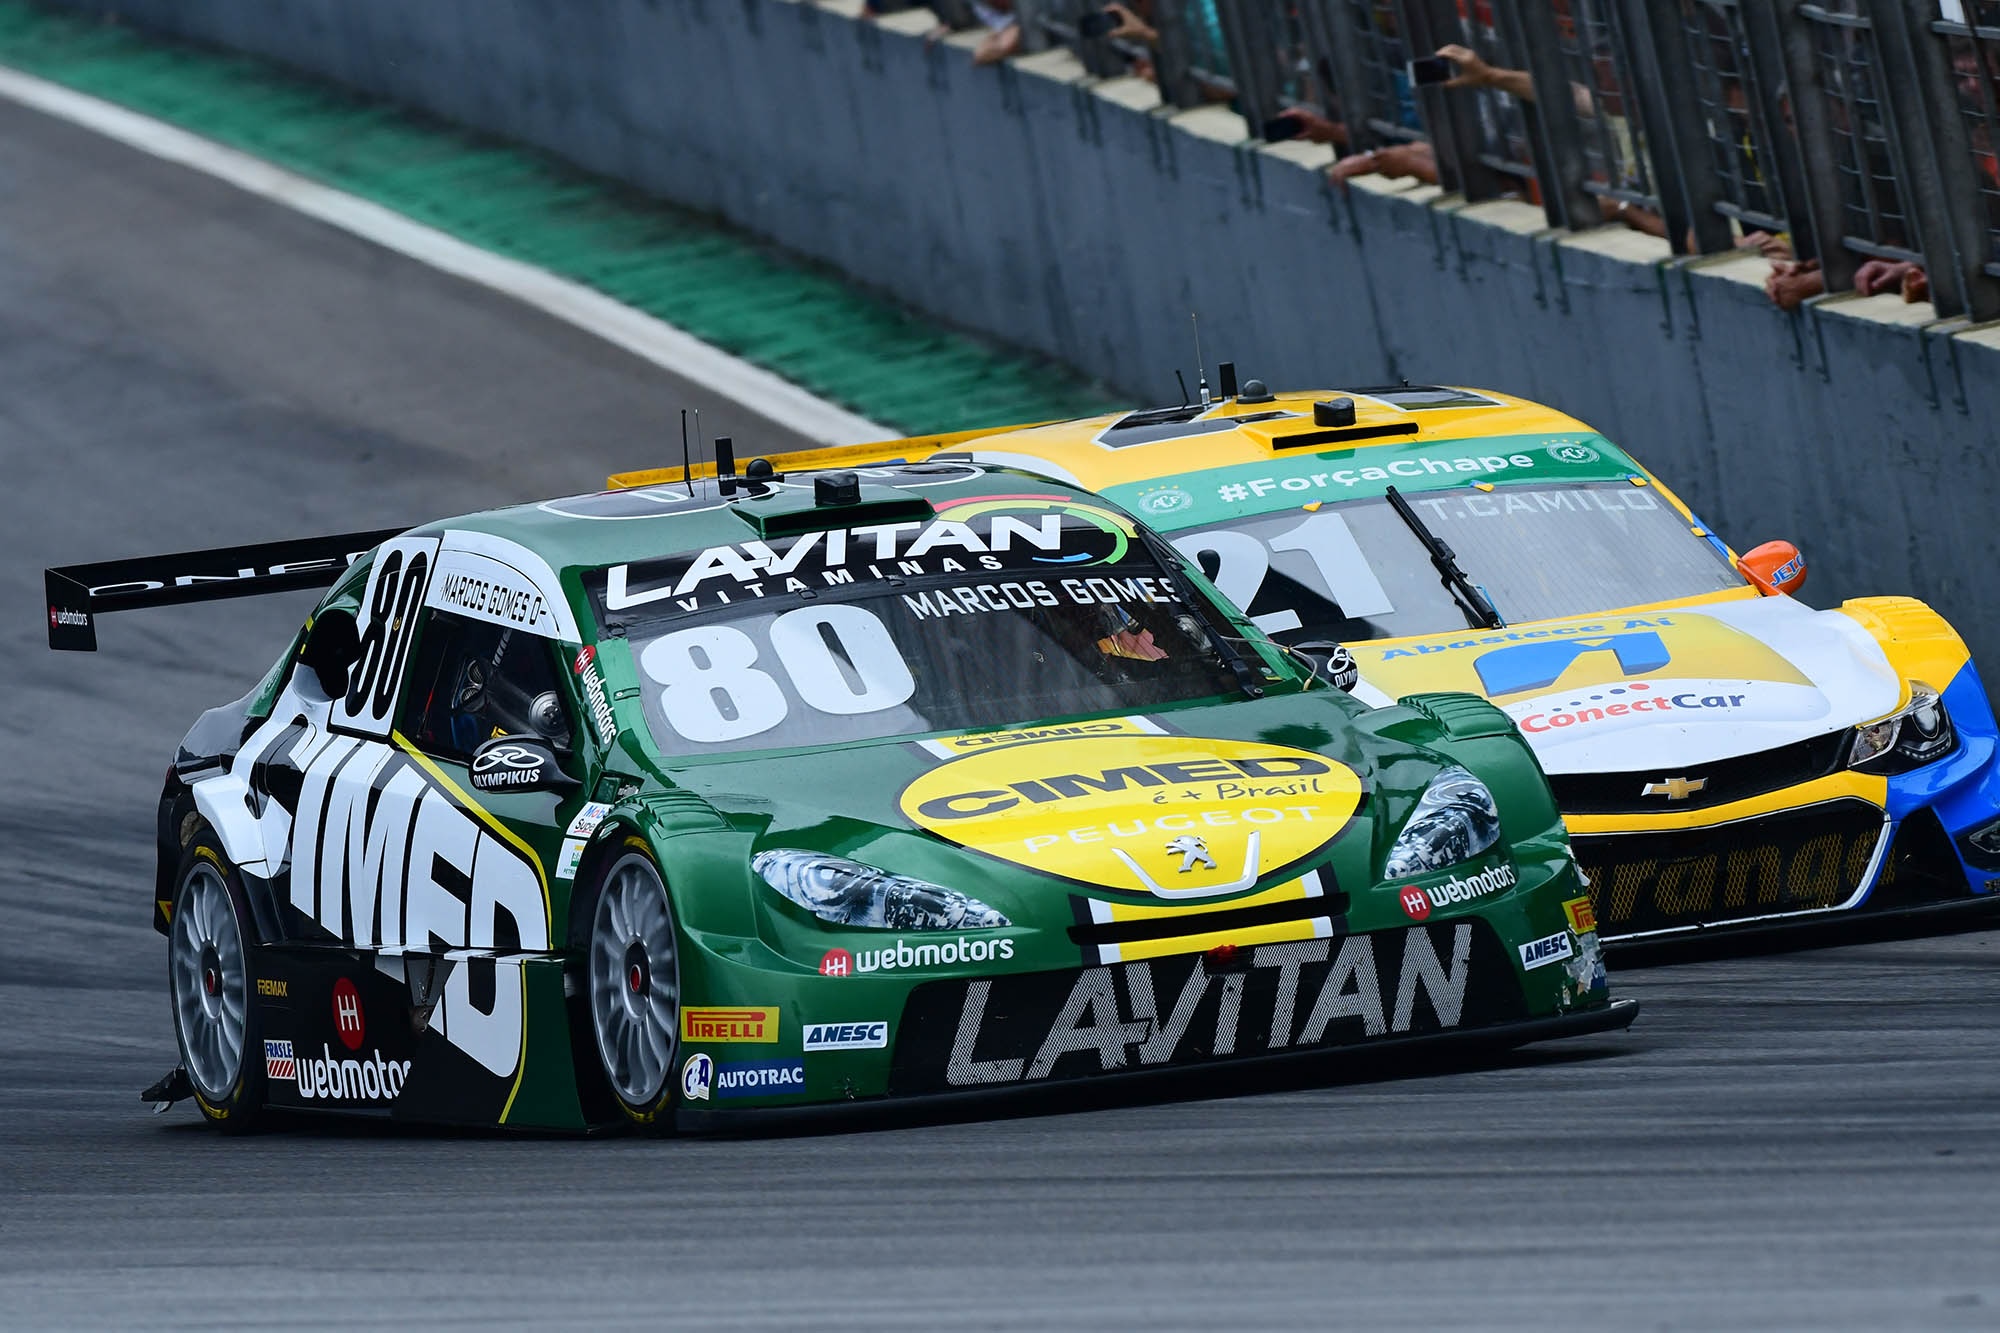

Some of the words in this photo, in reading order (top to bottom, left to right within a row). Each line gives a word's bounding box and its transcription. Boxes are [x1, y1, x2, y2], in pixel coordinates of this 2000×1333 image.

[1218, 453, 1534, 502] #ForçaChape
[1419, 489, 1659, 521] T.CAMILO
[606, 514, 1063, 611] LAVITAN
[1169, 513, 1396, 635] 21
[440, 573, 489, 611] MARCOS
[487, 585, 530, 622] GOMES
[676, 555, 1003, 612] VITAMINAS
[902, 580, 1060, 620] MARCOS
[56, 608, 88, 627] webmotors
[345, 549, 428, 721] 80
[1381, 624, 1609, 661] Abastece
[640, 604, 916, 743] 80
[582, 663, 617, 745] webmotors
[1520, 692, 1745, 733] ConectCar
[955, 724, 1123, 747] CIMED
[473, 768, 540, 786] OLYMPIKUS
[918, 757, 1332, 820] CIMED
[1216, 779, 1324, 800] Brasil
[1025, 806, 1321, 854] PEUGEOT
[1426, 866, 1516, 907] webmotors
[856, 937, 1014, 973] webmotors
[1525, 935, 1568, 963] ANESC
[257, 979, 288, 997] FREMAX
[946, 923, 1472, 1086] LAVITAN
[686, 1011, 766, 1038] PIRELLI
[807, 1024, 884, 1043] ANESC
[717, 1067, 804, 1089] AUTOTRAC
